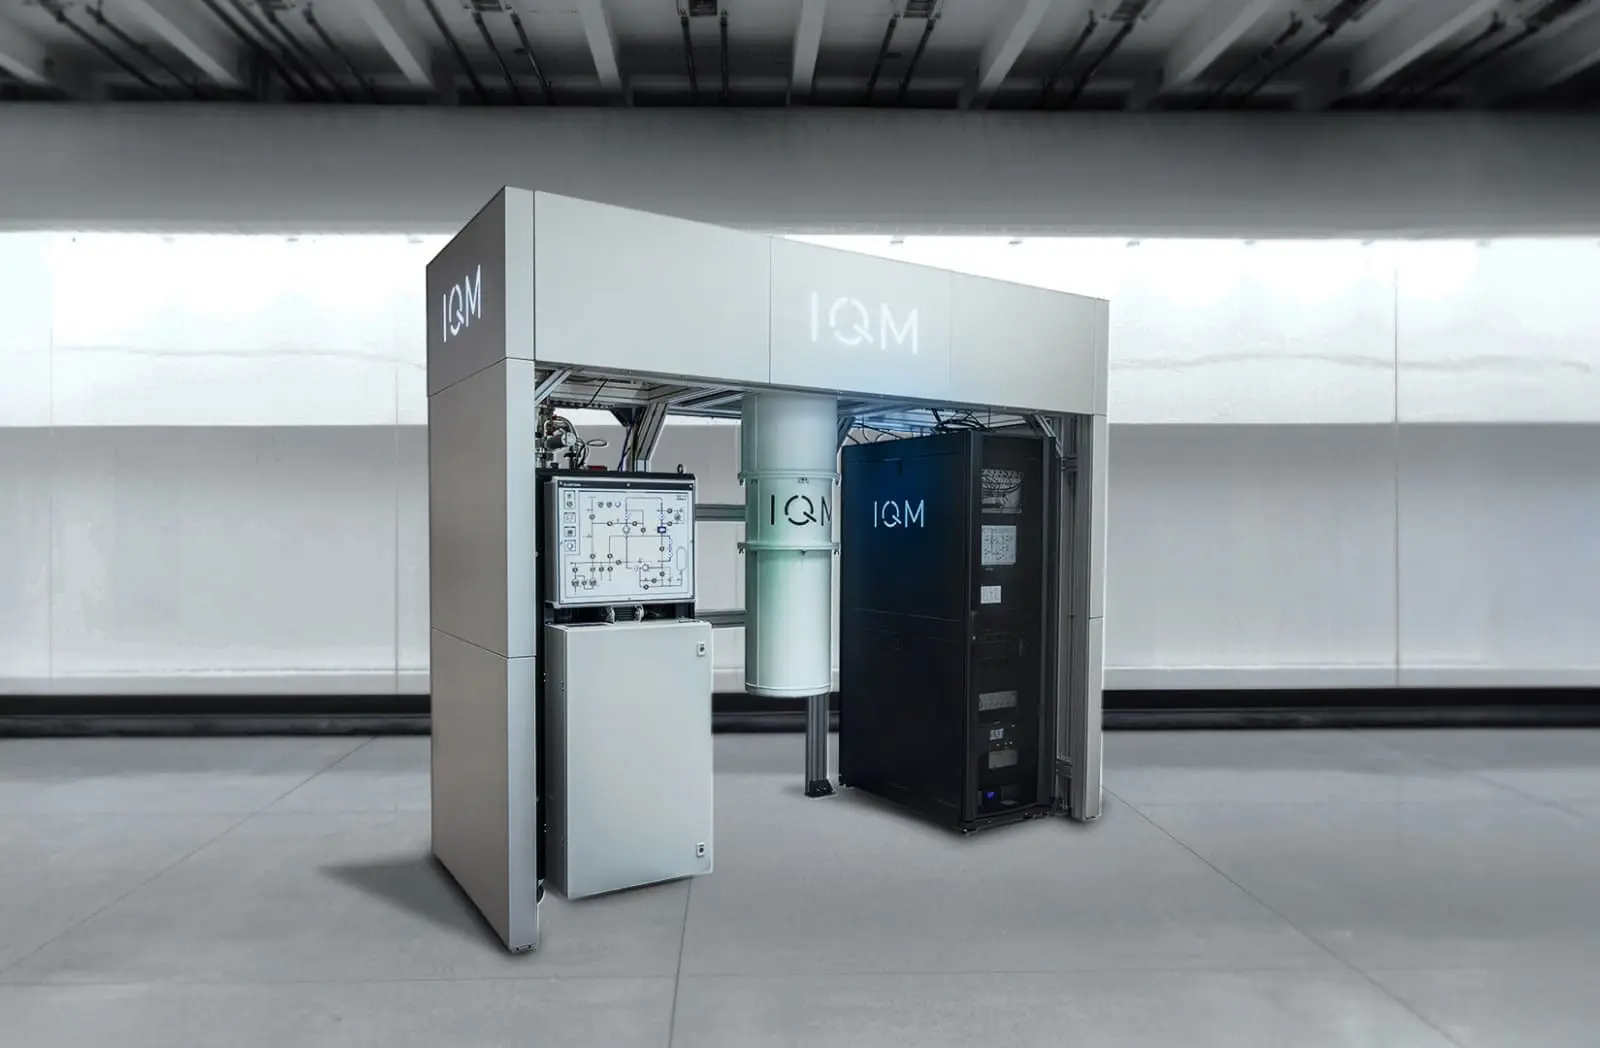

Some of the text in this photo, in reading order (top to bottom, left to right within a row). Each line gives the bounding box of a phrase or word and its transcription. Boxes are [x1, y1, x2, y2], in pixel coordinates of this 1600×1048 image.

[443, 264, 481, 342] IQM
[810, 291, 918, 355] IQM
[873, 499, 925, 528] IQM
